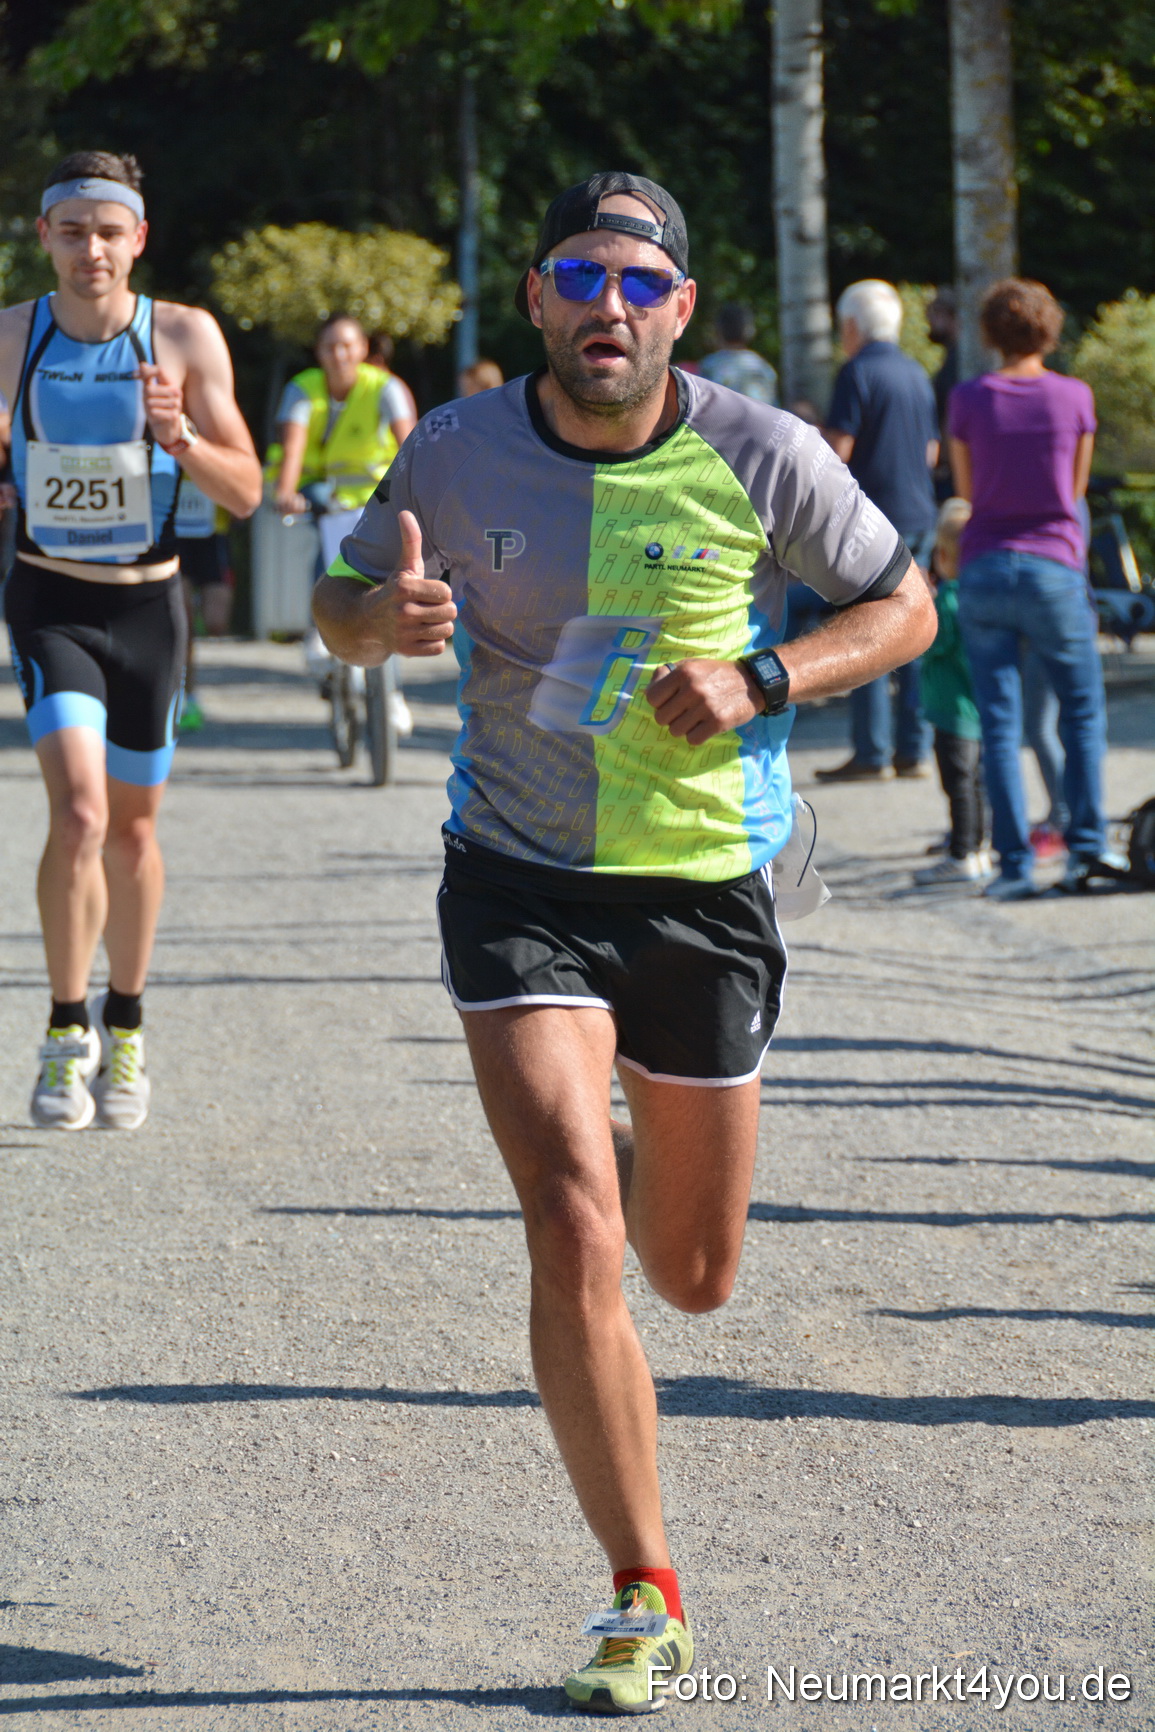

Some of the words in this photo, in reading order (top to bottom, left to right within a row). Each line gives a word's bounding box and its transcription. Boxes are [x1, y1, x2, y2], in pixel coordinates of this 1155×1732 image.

[45, 477, 125, 511] 2251
[67, 529, 113, 544] Daniel
[644, 563, 666, 571] PARTL
[667, 564, 706, 573] NEUMARKT
